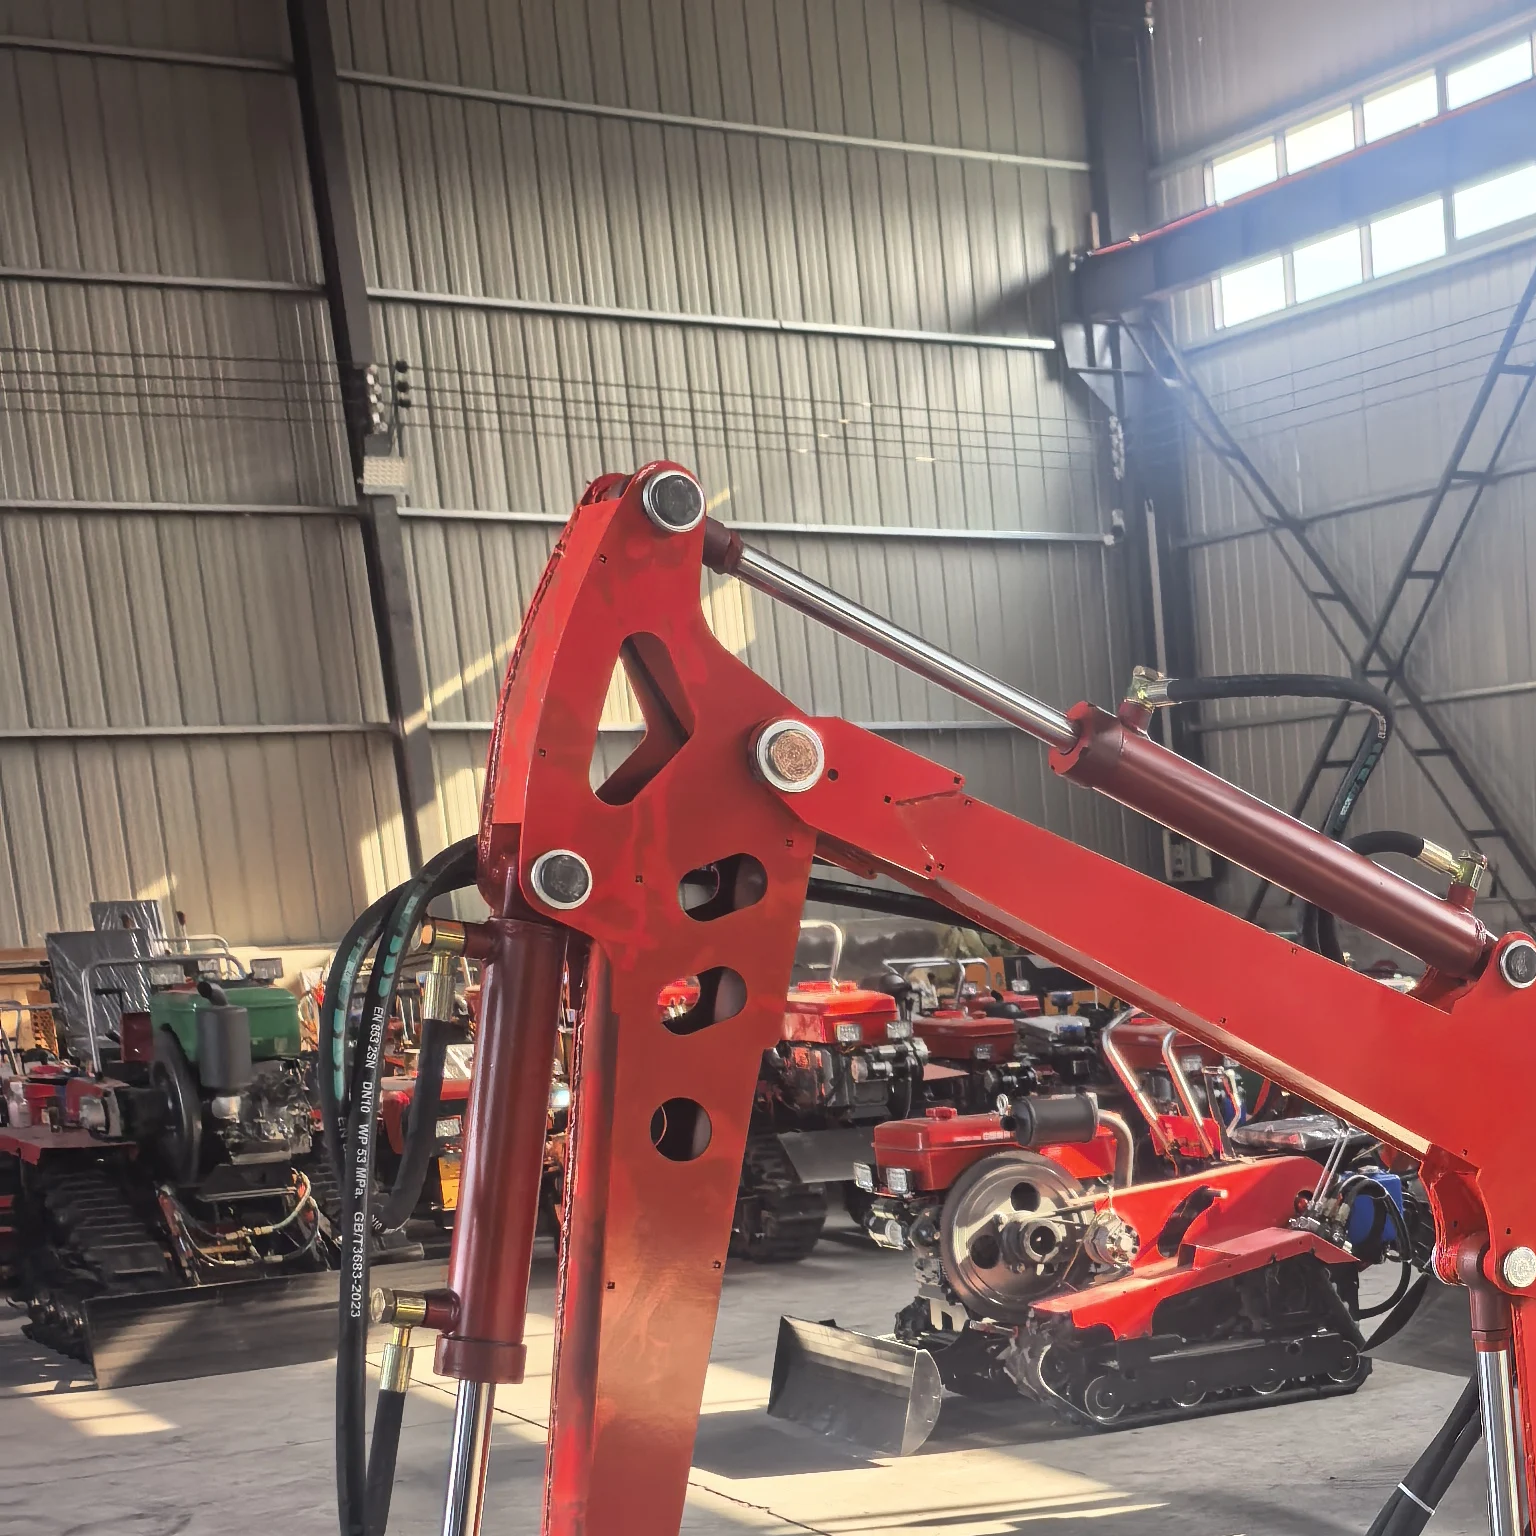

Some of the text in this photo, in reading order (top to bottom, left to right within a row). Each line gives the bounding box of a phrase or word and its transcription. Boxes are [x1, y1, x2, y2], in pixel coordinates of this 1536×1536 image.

[350, 1006, 384, 1318] EN 853 2SN DN10 WP 53 MPa. GB/T3683-2023
